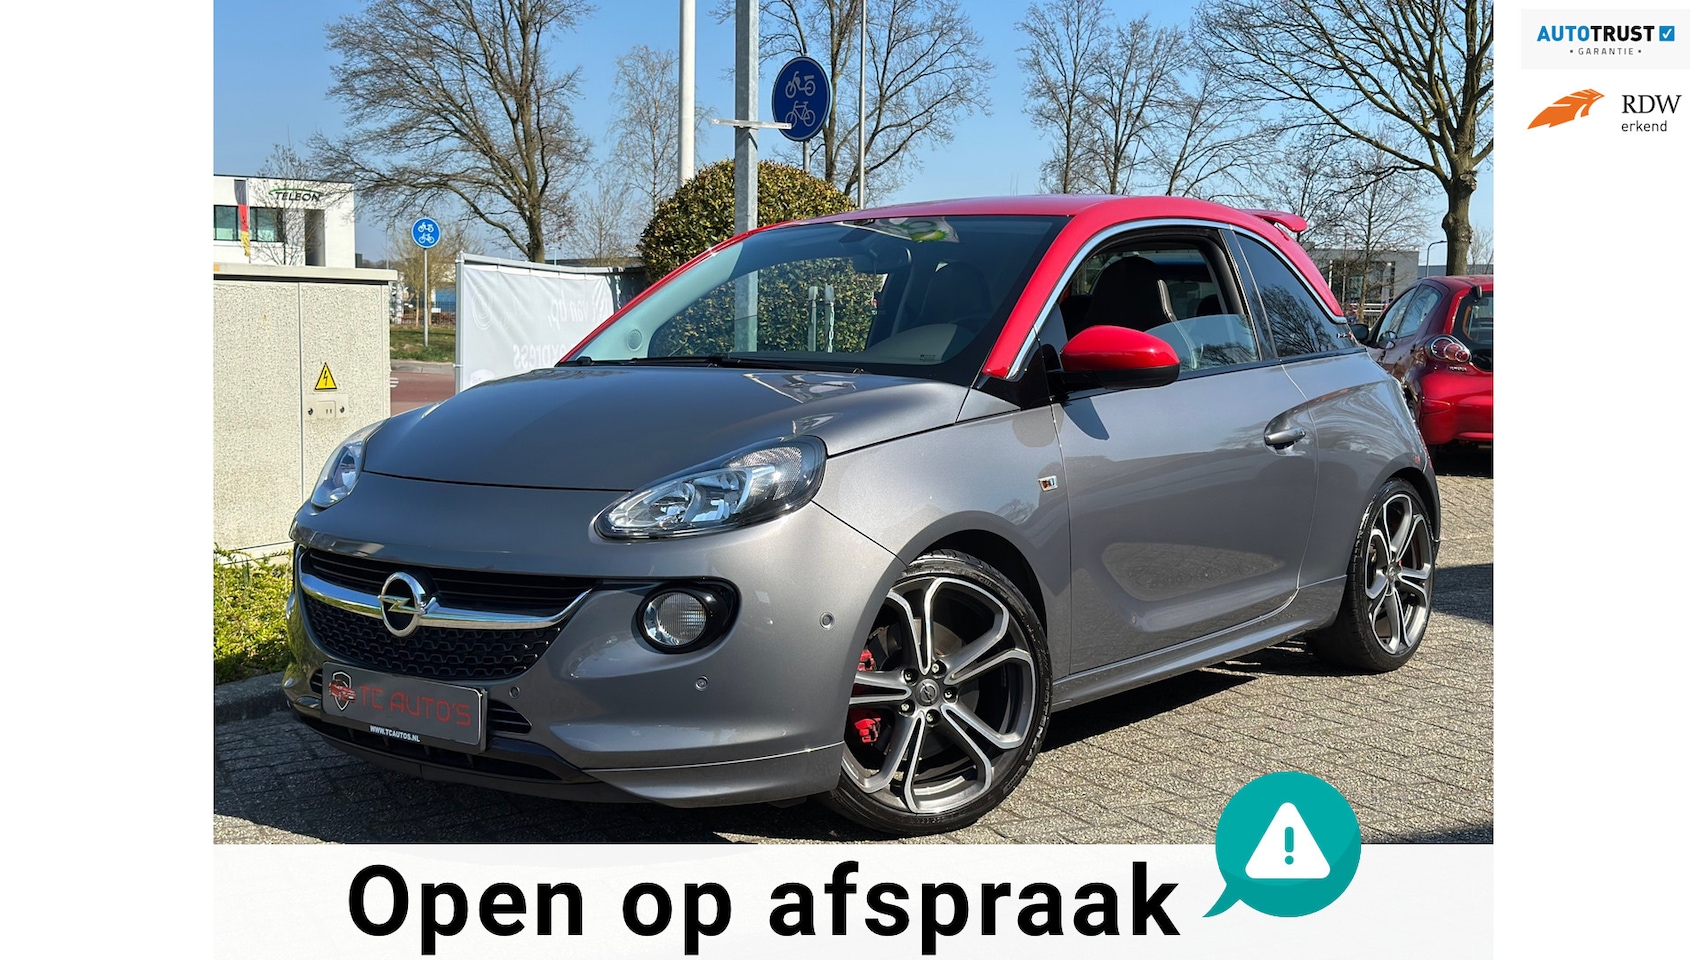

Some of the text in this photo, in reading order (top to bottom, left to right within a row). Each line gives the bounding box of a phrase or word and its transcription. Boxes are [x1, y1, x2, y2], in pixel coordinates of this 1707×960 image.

[275, 190, 321, 202] TELEON
[359, 685, 472, 727] TC AUTO'S
[369, 724, 421, 743] WWW.TCAUTOS.NL
